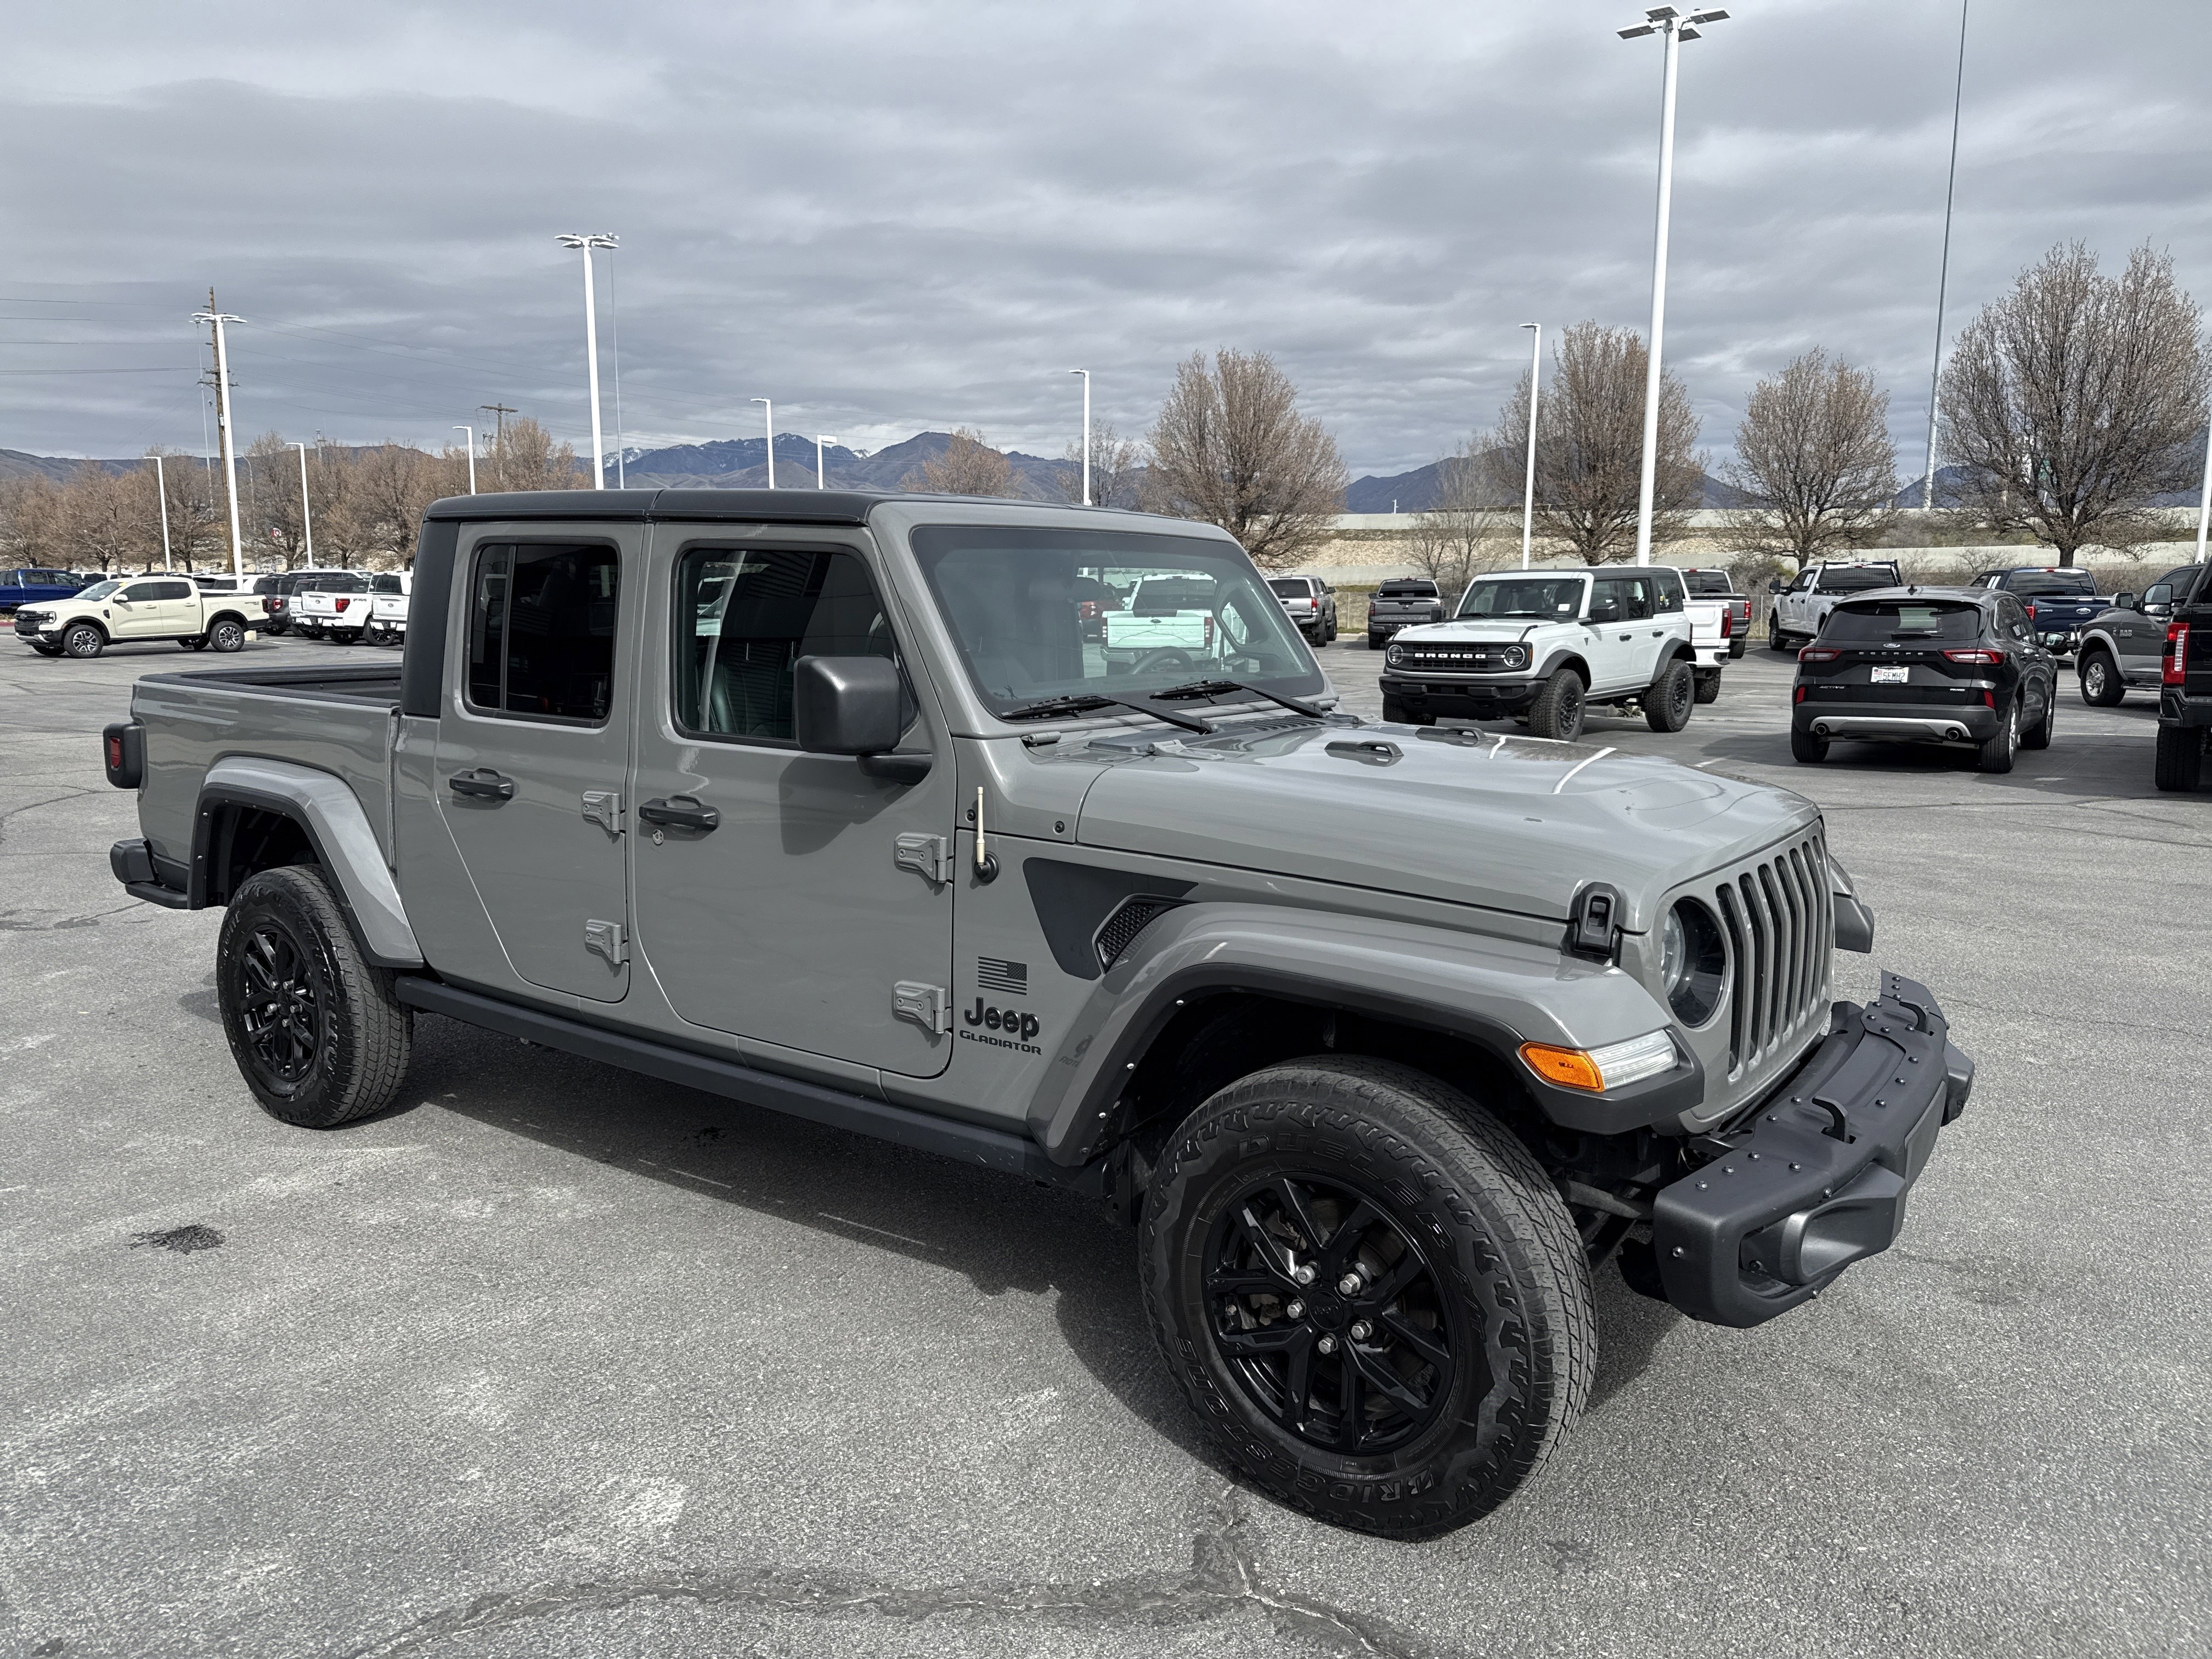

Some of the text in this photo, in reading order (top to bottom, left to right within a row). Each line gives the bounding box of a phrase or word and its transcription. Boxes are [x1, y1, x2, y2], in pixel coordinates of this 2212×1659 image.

[960, 1029, 1042, 1056] GLADIATOR
[964, 996, 1040, 1041] Jeep
[1237, 1131, 1454, 1249] DUELER
[1172, 1335, 1436, 1504] BRIDGESTONE
